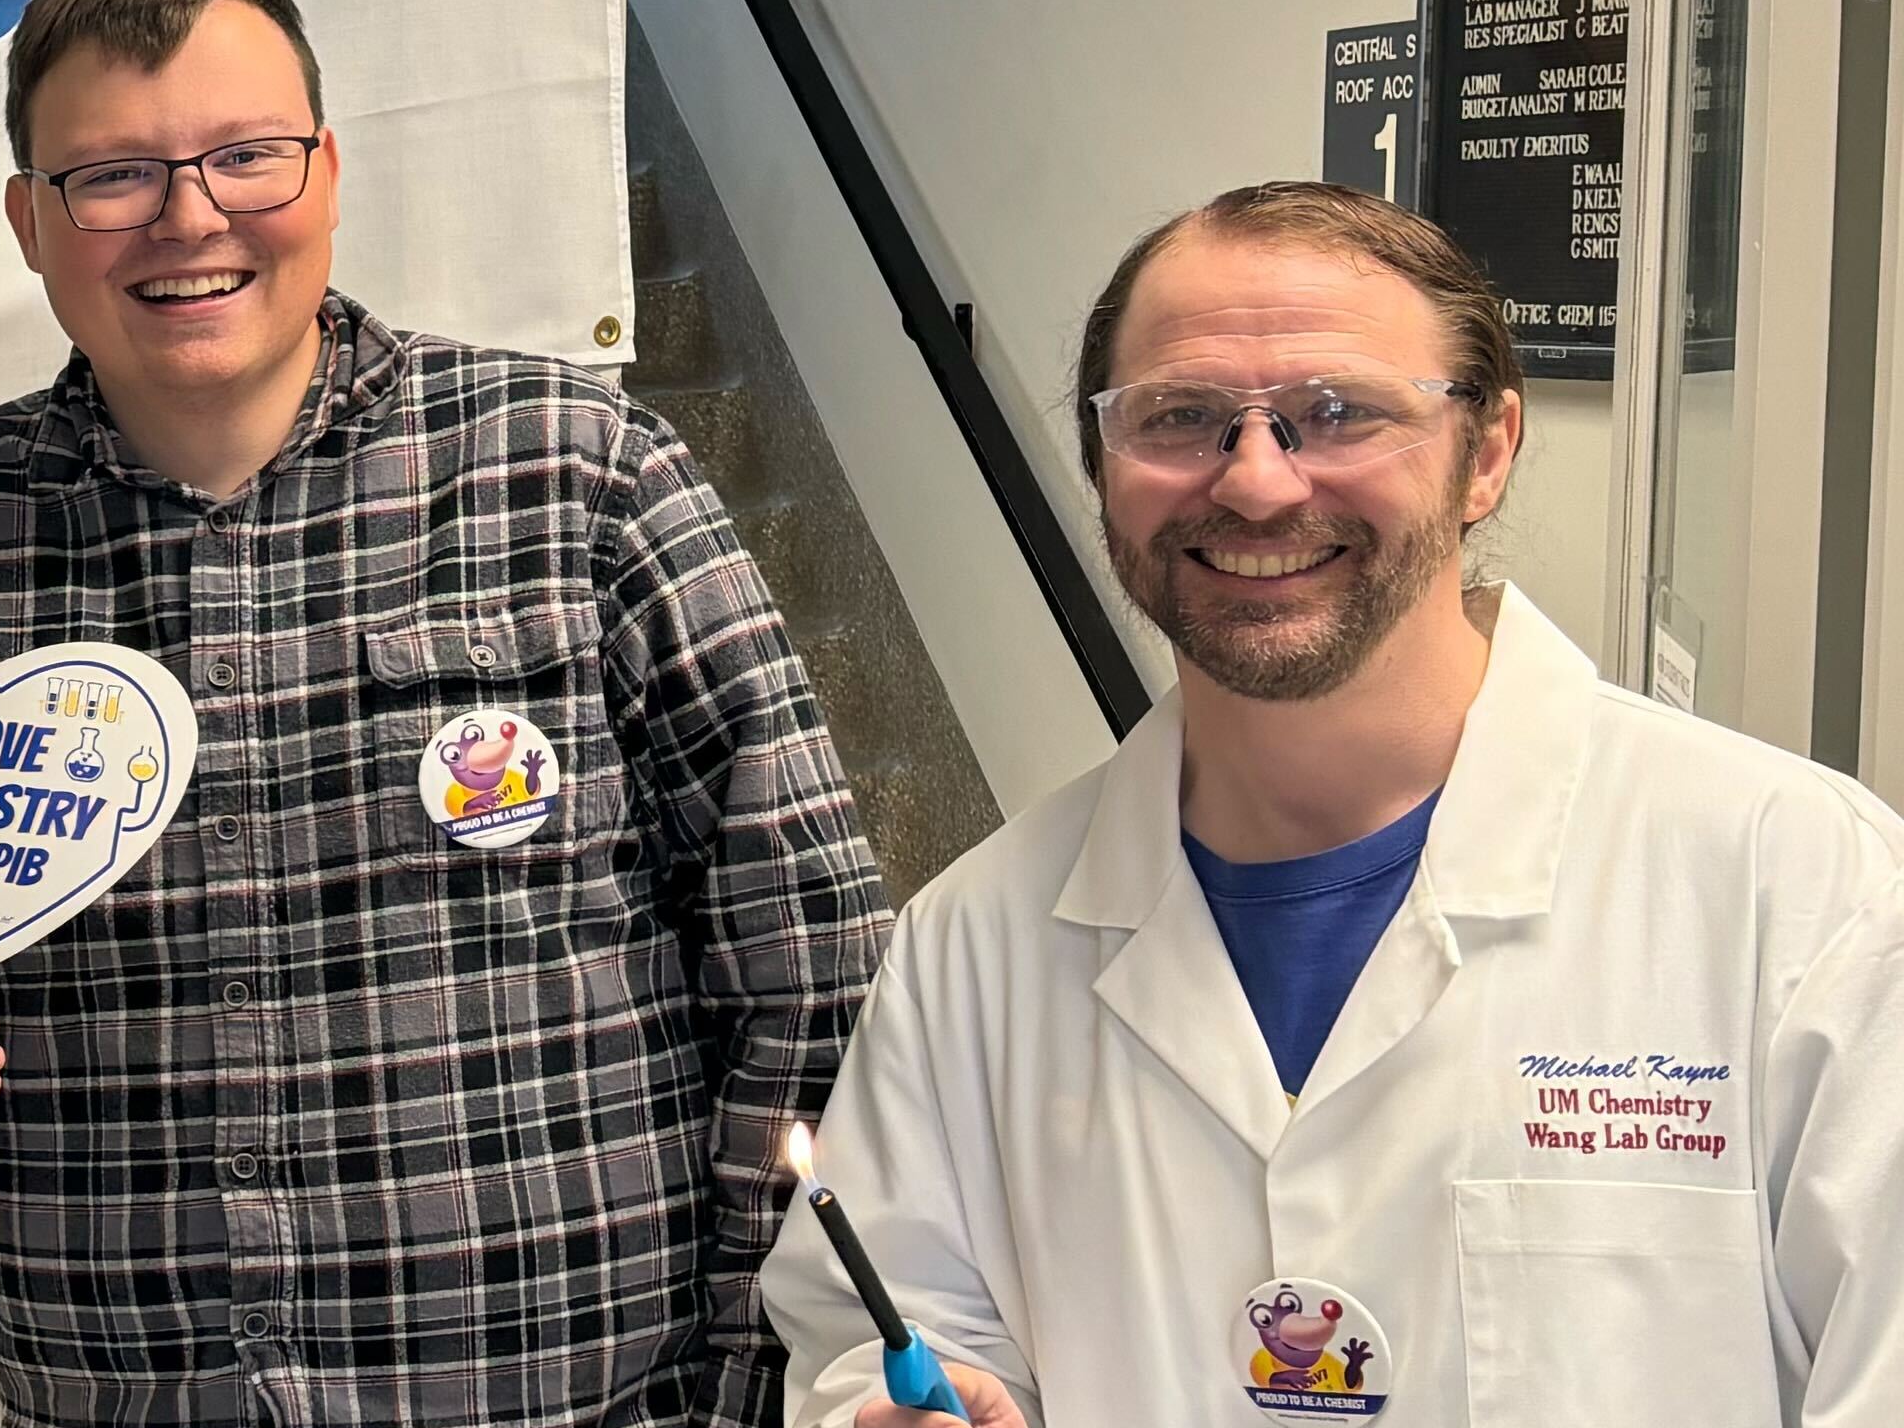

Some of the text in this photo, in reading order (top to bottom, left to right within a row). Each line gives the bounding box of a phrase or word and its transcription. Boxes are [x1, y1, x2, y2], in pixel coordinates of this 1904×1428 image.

[1465, 4, 1493, 26] LAB
[1464, 28, 1490, 49] RES
[1493, 19, 1568, 46] SPECIALIST
[1334, 35, 1397, 66] CENTRAL
[1335, 78, 1375, 104] ROOF
[1460, 74, 1501, 97] ADMIN
[1539, 66, 1586, 90] SARAH
[1461, 89, 1626, 119] BUDGET ANALYST M REIM
[1374, 113, 1398, 204] 1
[1461, 134, 1590, 160] FACULTY EMERITUS
[1572, 164, 1582, 186] E
[1572, 189, 1582, 210] D
[1572, 213, 1582, 235] R
[1503, 299, 1551, 325] OFFICE
[1519, 1054, 1730, 1086] Michael Kayne
[1538, 1088, 1712, 1122] UM Chemistry
[1524, 1122, 1727, 1159] Wang Lab Group
